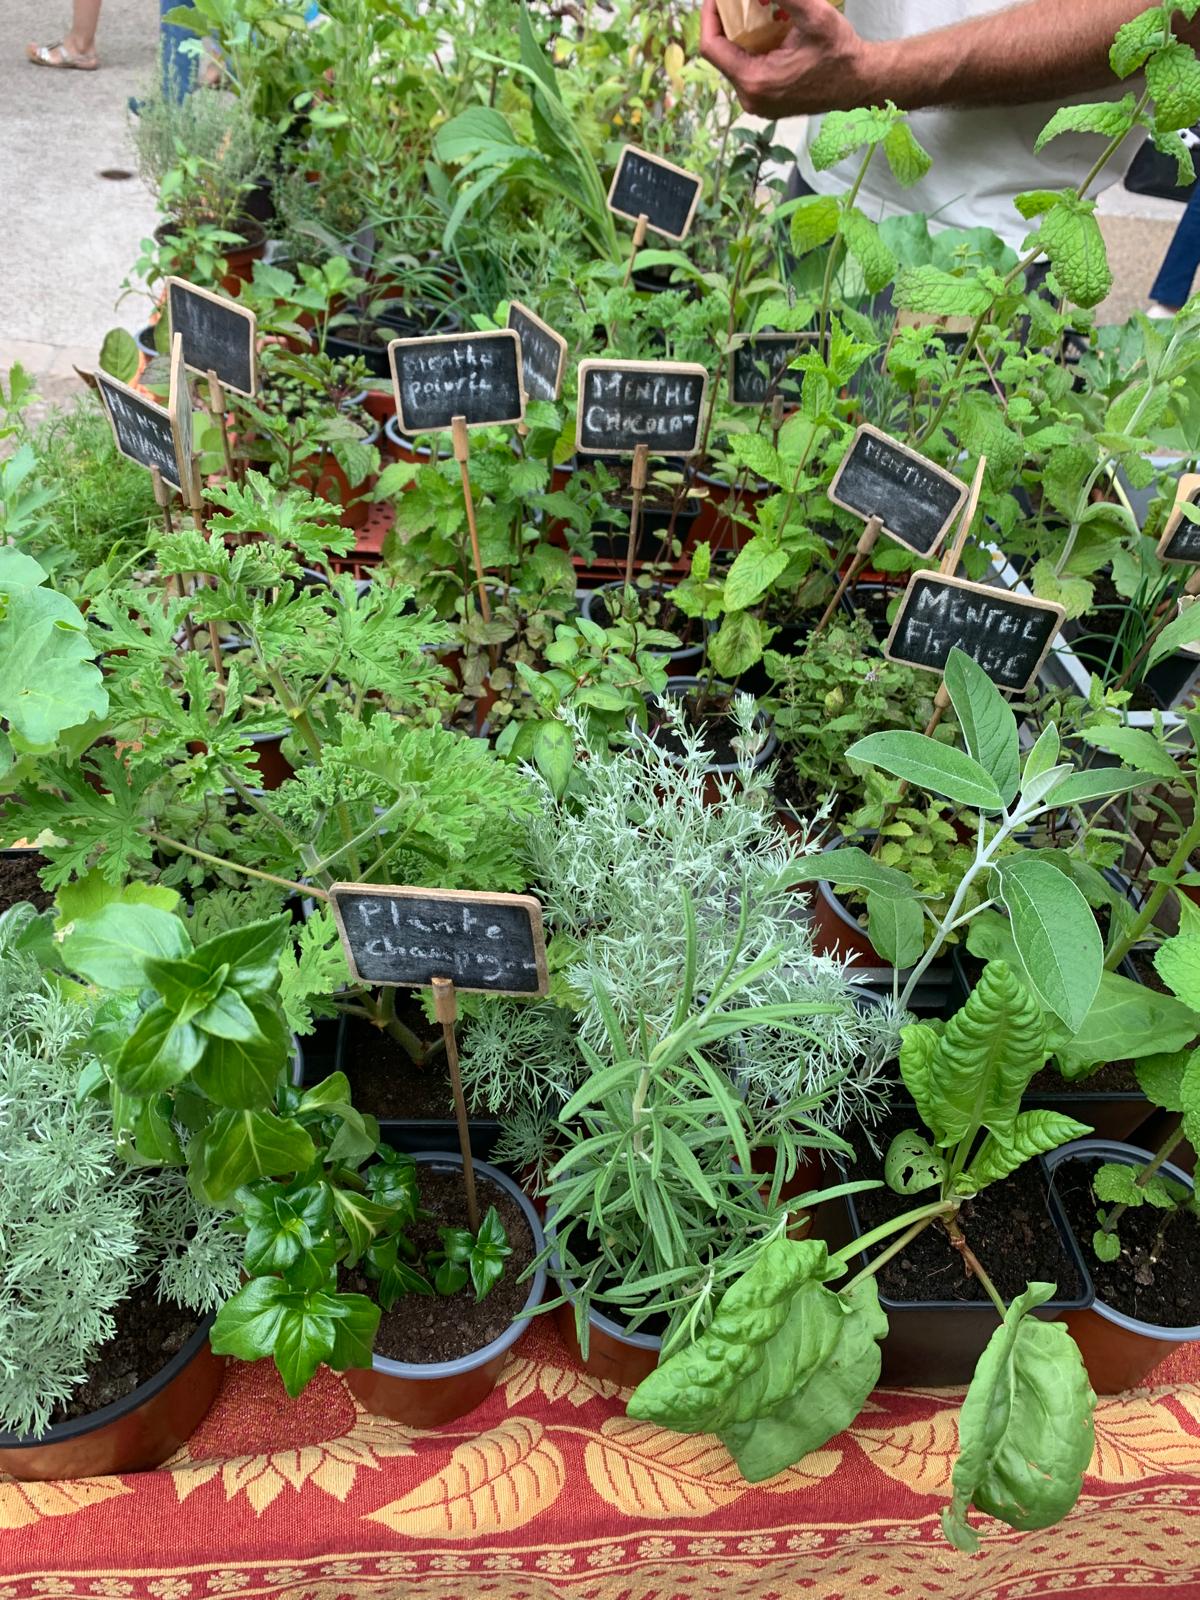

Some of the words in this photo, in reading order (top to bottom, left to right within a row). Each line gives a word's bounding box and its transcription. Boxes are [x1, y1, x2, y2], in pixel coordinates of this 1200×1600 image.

[592, 371, 696, 407] MENTHE
[585, 405, 696, 435] CHOCOLAT
[916, 585, 1044, 642] MENTHE
[355, 899, 504, 941] Plante
